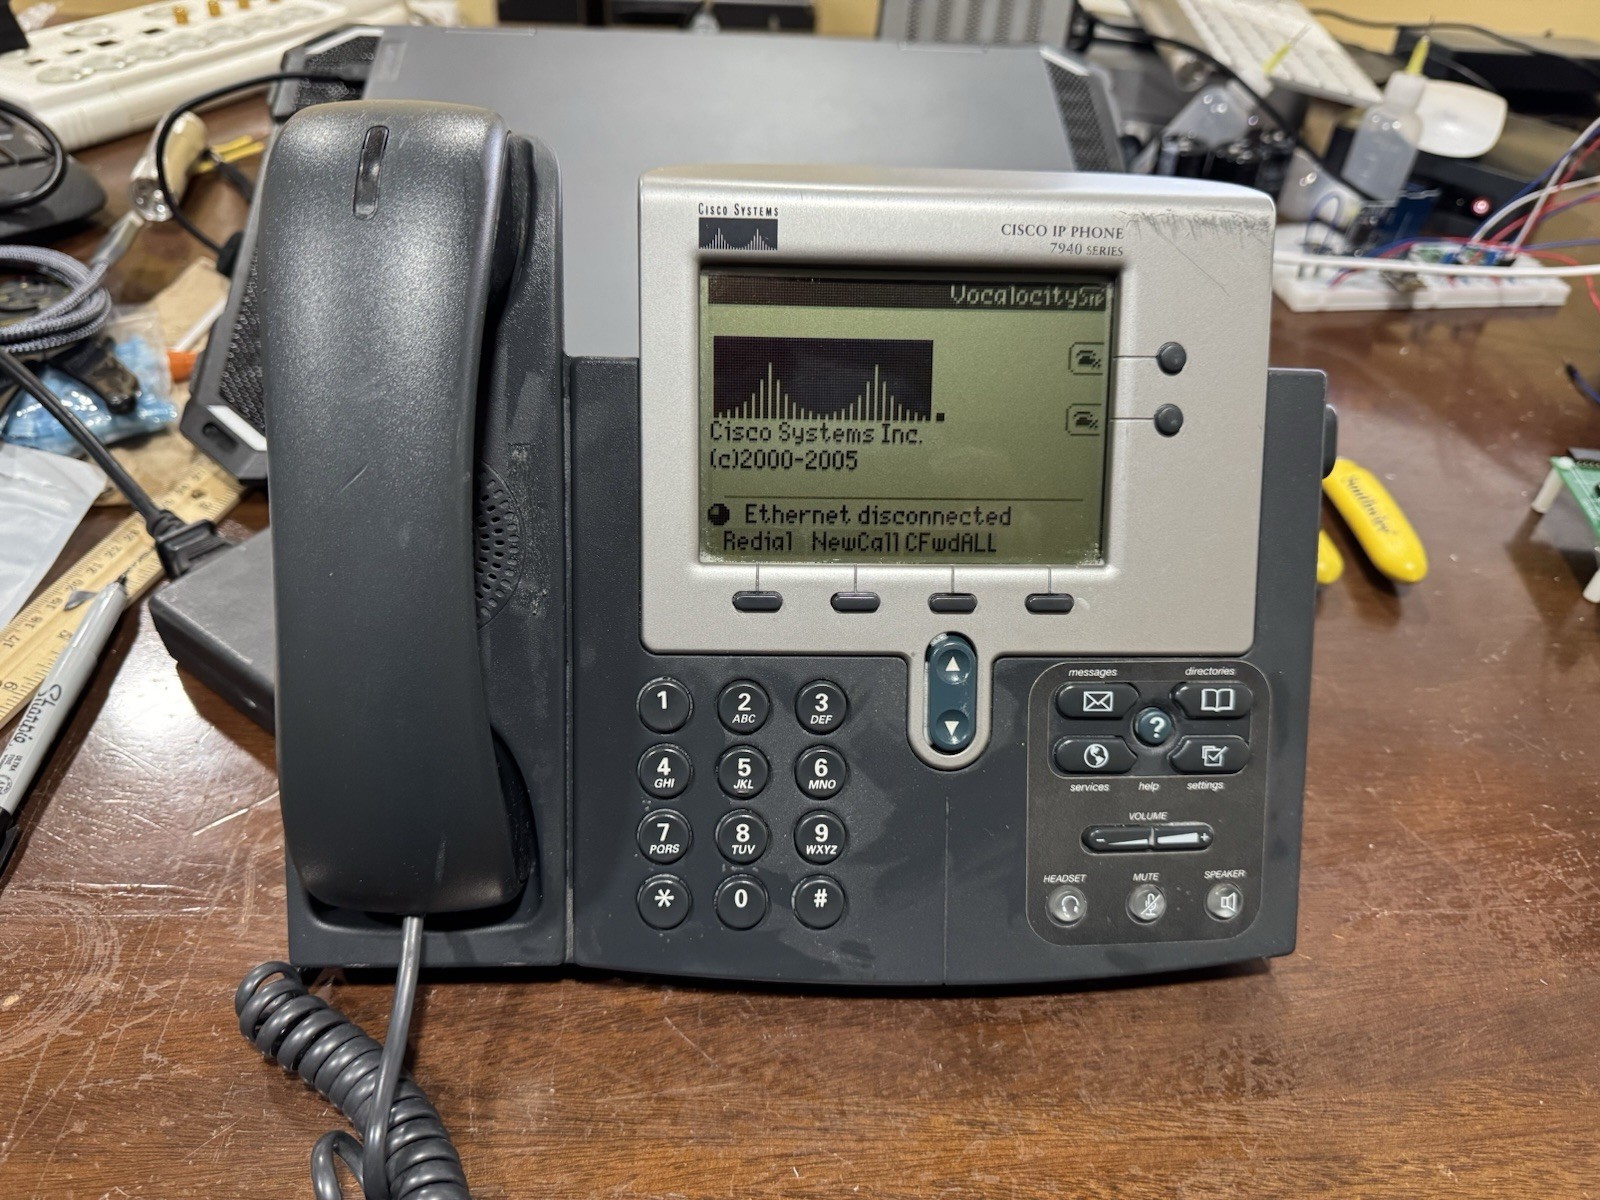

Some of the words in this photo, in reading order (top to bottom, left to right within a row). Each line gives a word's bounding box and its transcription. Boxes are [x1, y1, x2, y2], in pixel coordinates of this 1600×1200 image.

[1001, 223, 1048, 237] CISCO
[1052, 226, 1067, 237] IP
[1071, 226, 1124, 239] PHONE
[1050, 242, 1082, 256] 7940
[1086, 246, 1124, 256] SERIES
[710, 422, 772, 441] Cisco
[779, 422, 874, 444] Systems
[881, 424, 924, 445] Inc.
[710, 449, 859, 470] (c)2000-2005
[745, 504, 851, 525] Ethernet
[858, 506, 1012, 526] disconnected
[724, 531, 792, 552] Redial
[812, 531, 899, 552] NewCall
[3, 633, 20, 648] 17
[1069, 668, 1117, 677] messages
[1185, 667, 1235, 676] directories
[657, 691, 667, 709] 1
[738, 693, 751, 711] 2
[815, 693, 828, 712] 3
[732, 714, 756, 723] ABC
[811, 715, 832, 724] DEF
[657, 758, 671, 775] 4
[737, 758, 751, 776] 5
[814, 758, 828, 776] 6
[654, 778, 675, 788] GHI
[733, 779, 754, 789] JKL
[809, 780, 836, 789] MNO
[1070, 783, 1110, 792] services
[1138, 782, 1159, 792] help
[1187, 781, 1224, 791] settings
[1129, 812, 1167, 820] VOLUME
[657, 823, 670, 841] 7
[736, 824, 750, 842] 8
[815, 824, 828, 842] 9
[650, 844, 680, 854] PQRS
[732, 845, 755, 854] TUV
[806, 845, 837, 854] WXYZ
[1043, 874, 1087, 882] HEADSET
[1133, 873, 1159, 881] MUTE
[1204, 869, 1246, 879] SPEAKER
[735, 889, 748, 908] 0
